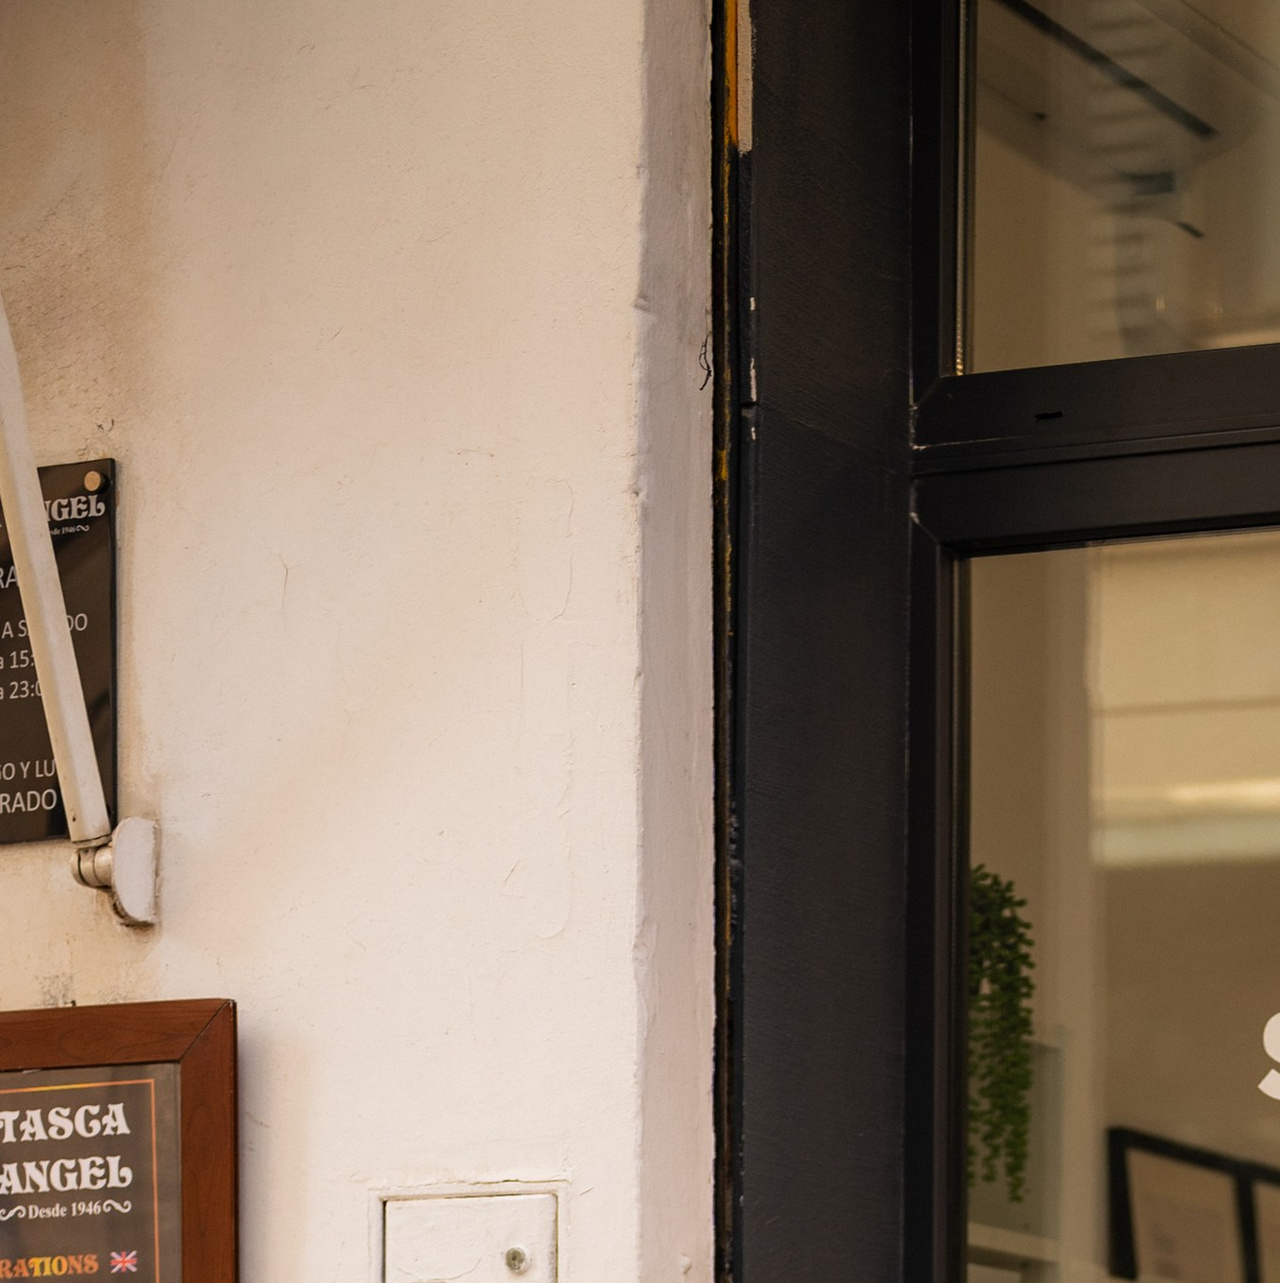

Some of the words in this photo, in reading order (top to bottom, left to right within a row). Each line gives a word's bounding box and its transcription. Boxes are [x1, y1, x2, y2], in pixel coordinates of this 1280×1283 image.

[0, 1103, 131, 1143] TASCA
[0, 1155, 133, 1195] ANGEL
[28, 1203, 67, 1220] Desde
[71, 1201, 101, 1216] 1946
